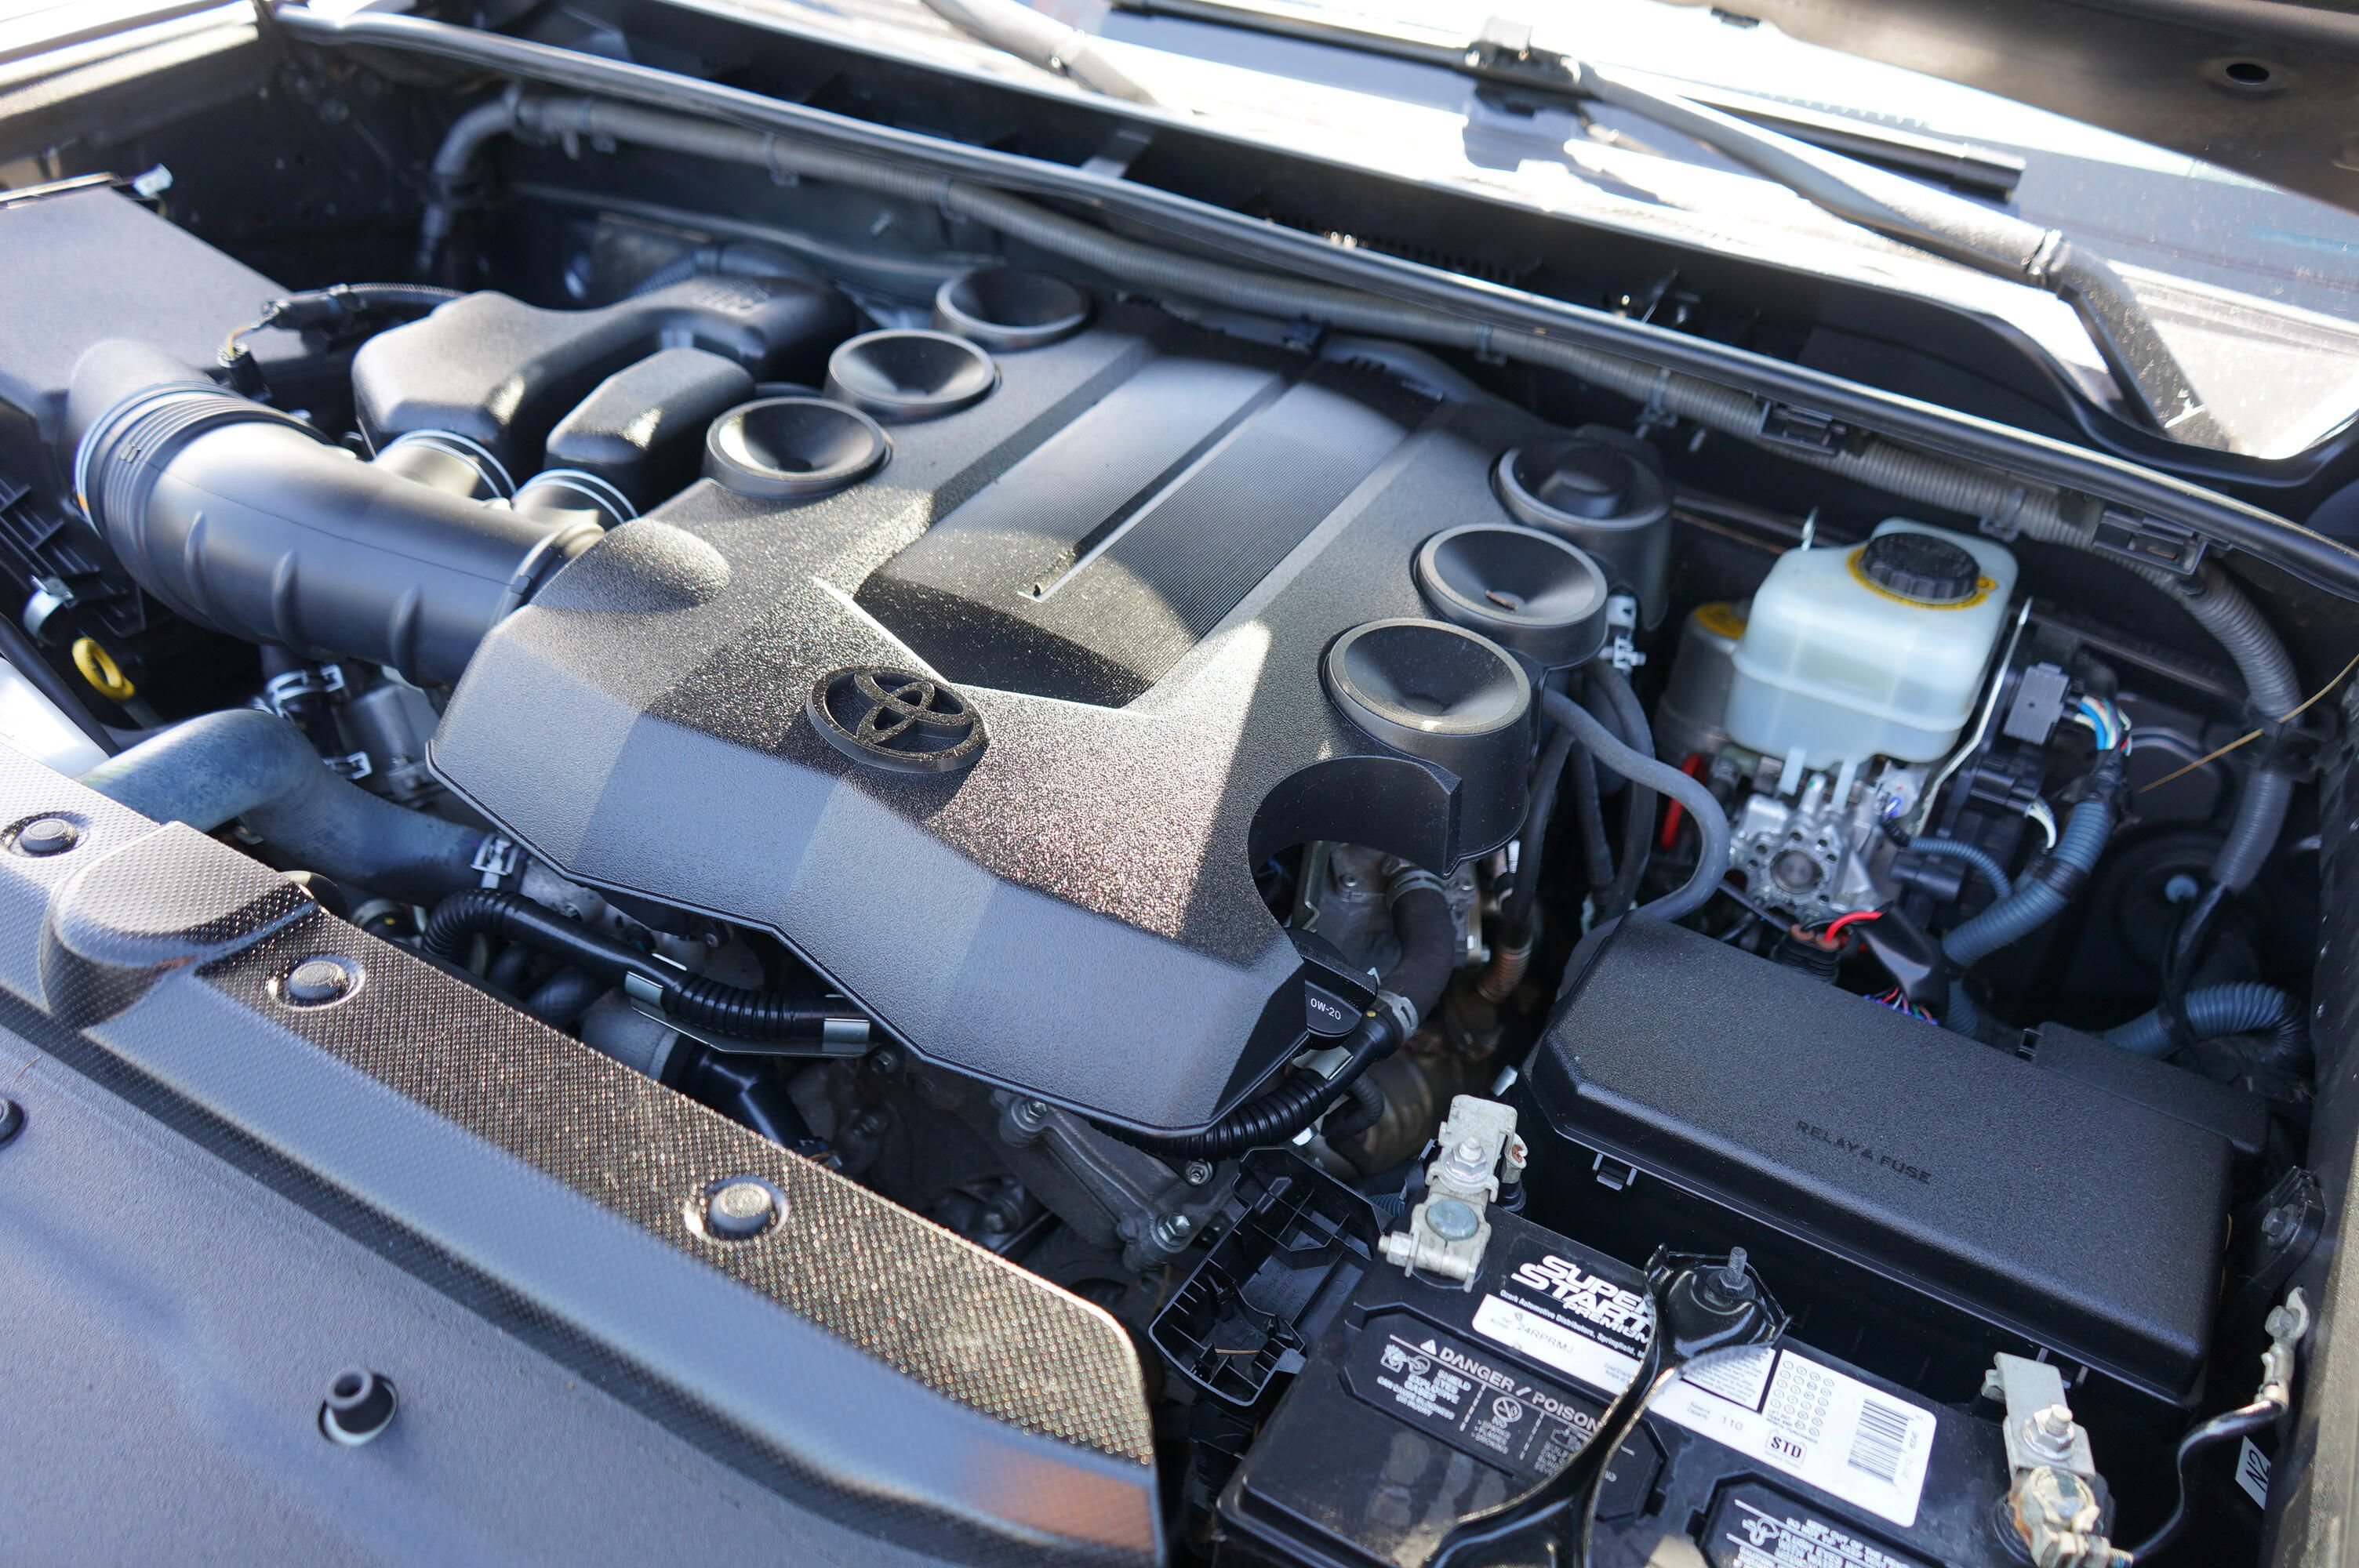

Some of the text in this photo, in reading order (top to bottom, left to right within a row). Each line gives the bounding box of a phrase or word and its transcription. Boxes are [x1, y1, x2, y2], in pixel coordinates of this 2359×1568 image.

[1310, 998, 1341, 1020] 0W-20
[1797, 1120, 1859, 1152] RELAY
[1880, 1156, 1932, 1185] FUSE
[1499, 1289, 1519, 1305] Ozark
[1518, 1296, 1557, 1320] Automotive
[1510, 1262, 1652, 1330] START
[1437, 1368, 1472, 1392] SHIELD
[1439, 1346, 1516, 1392] DANGER
[1492, 1415, 1508, 1429] NO
[1770, 1436, 1802, 1459] STD
[2246, 1449, 2270, 1493] N2
[1779, 1529, 1816, 1554] FLUSH
